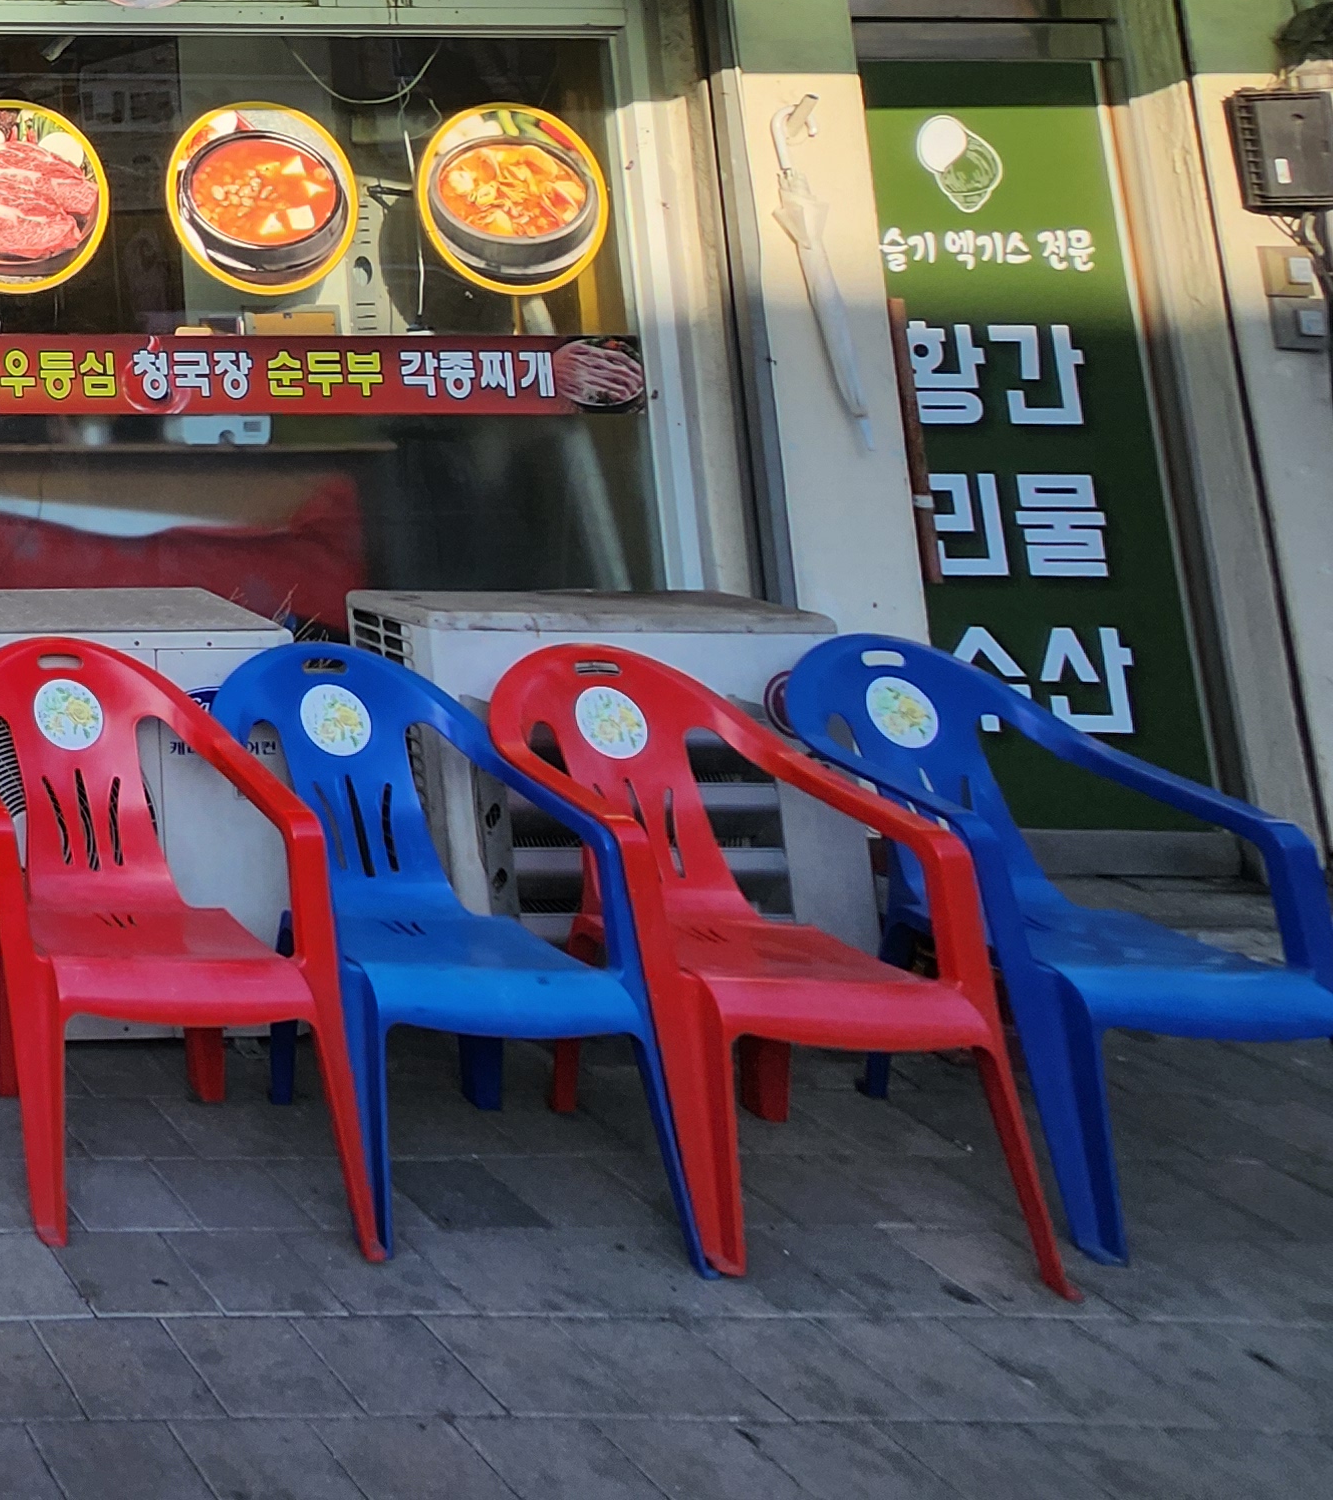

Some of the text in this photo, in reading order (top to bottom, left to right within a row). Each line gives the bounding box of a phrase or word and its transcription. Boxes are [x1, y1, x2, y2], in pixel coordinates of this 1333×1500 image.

[943, 229, 1033, 271] 엑기스
[1036, 229, 1097, 273] 전문
[132, 349, 253, 400] 청국장
[266, 349, 384, 397] 순두부
[398, 349, 557, 399] 각종찌개
[905, 320, 1086, 426] 황간
[927, 472, 1110, 578] 민물
